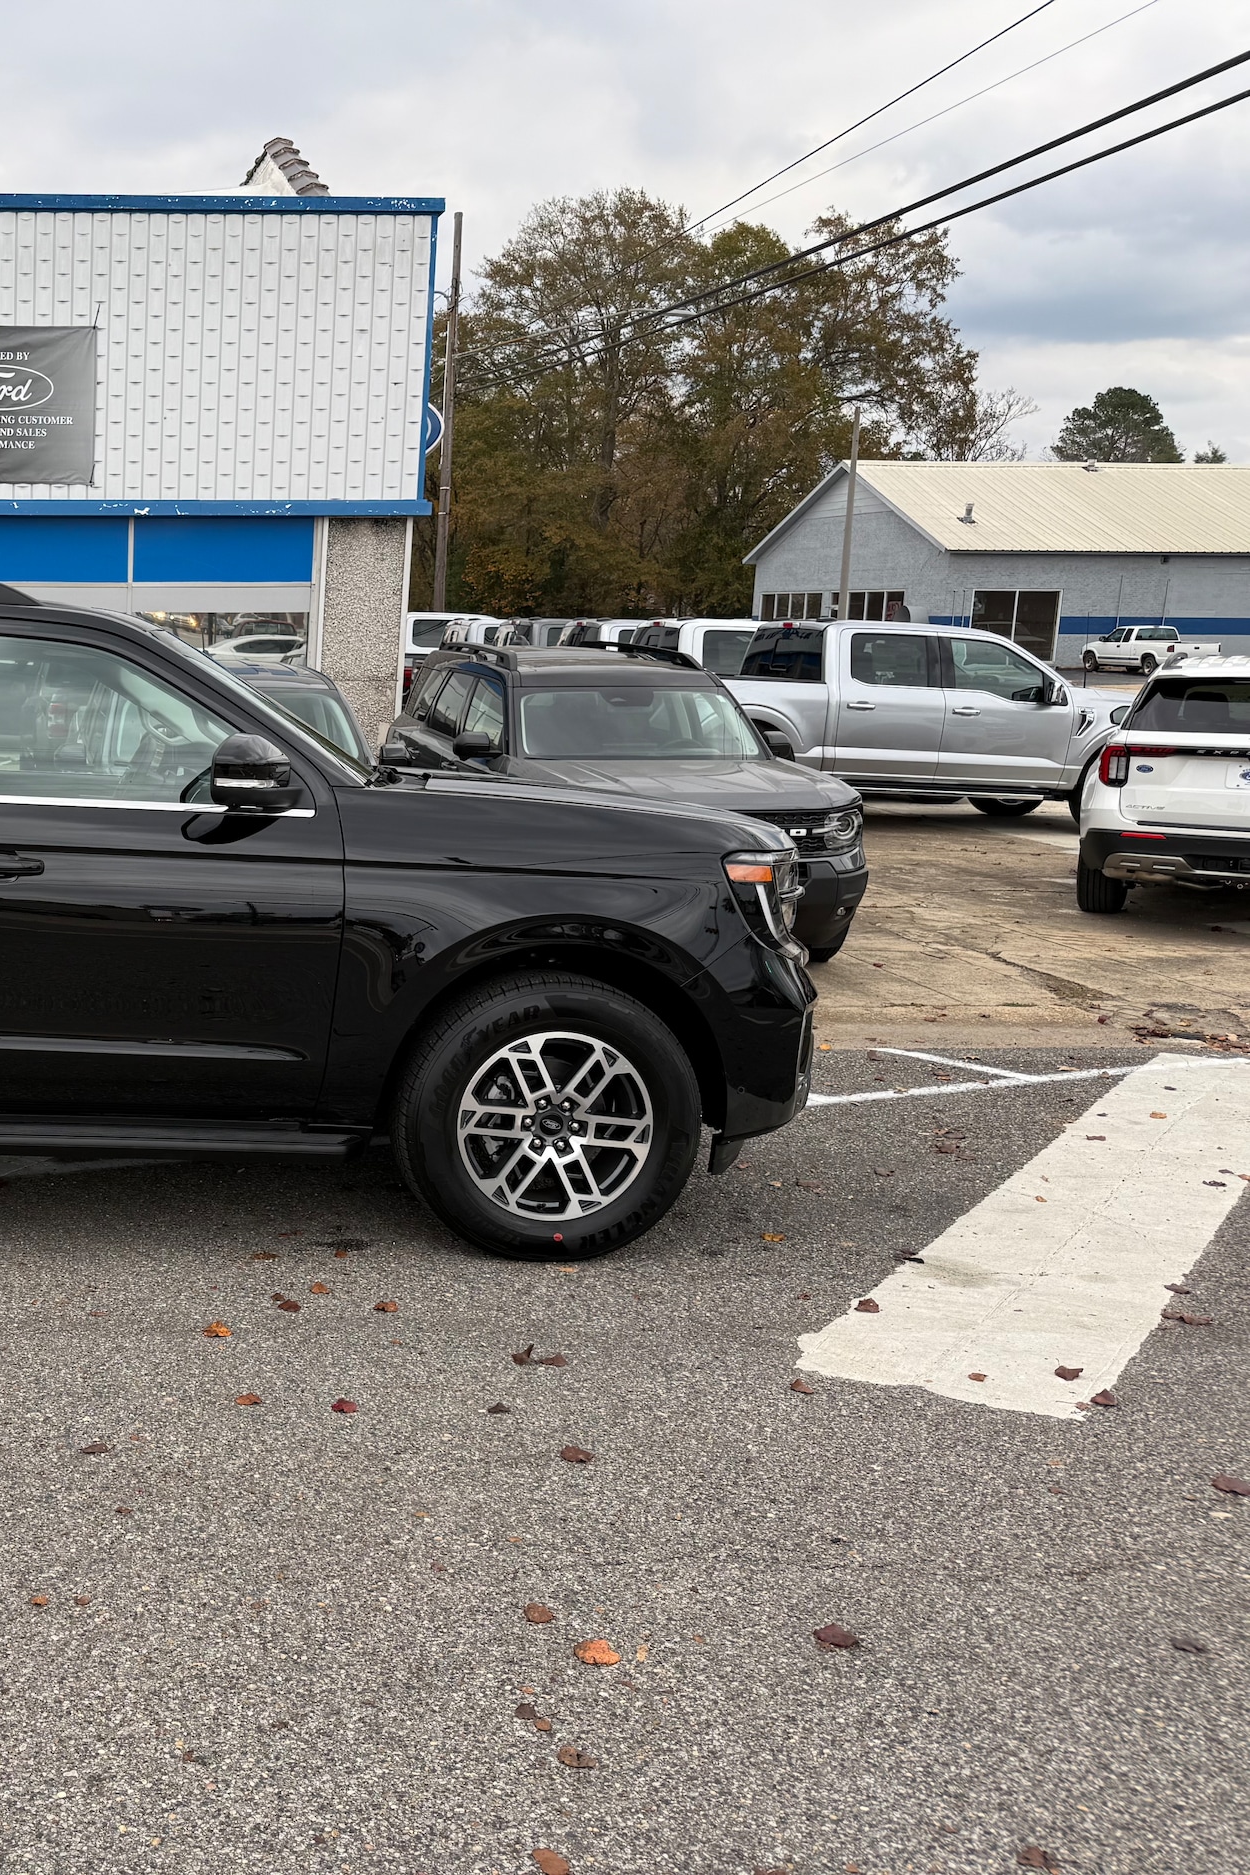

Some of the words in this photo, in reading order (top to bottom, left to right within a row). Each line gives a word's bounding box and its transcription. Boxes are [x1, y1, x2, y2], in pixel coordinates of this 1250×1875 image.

[16, 351, 30, 361] BY
[18, 415, 74, 425] CUSTOMER
[16, 427, 47, 437] SALES
